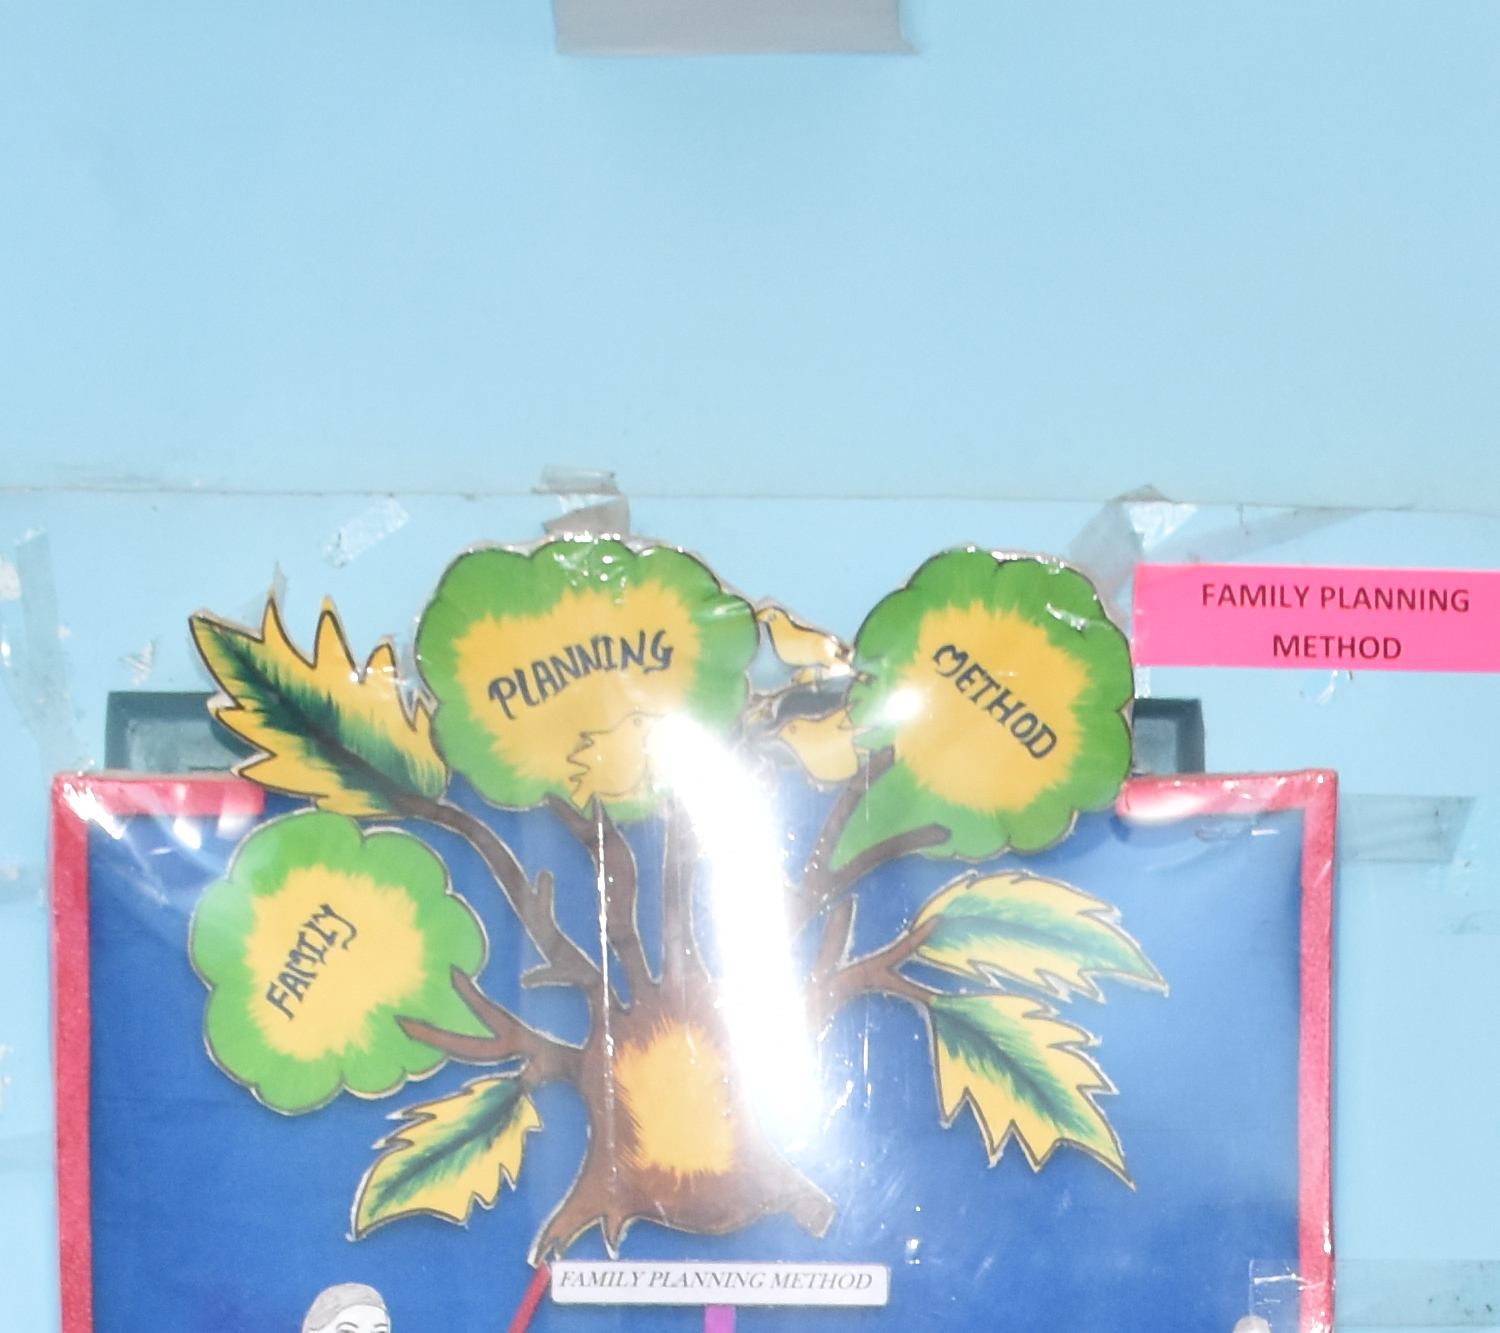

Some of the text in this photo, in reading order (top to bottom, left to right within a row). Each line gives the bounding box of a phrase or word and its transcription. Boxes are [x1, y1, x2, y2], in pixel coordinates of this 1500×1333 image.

[1202, 583, 1470, 613] FAMILY PLANNING
[486, 628, 675, 720] PLANNING
[1272, 634, 1402, 661] METHOD
[931, 643, 1059, 760] METHOD
[265, 903, 358, 1022] FAMILY
[559, 1270, 873, 1291] FAMILY PLANNING METHOD
